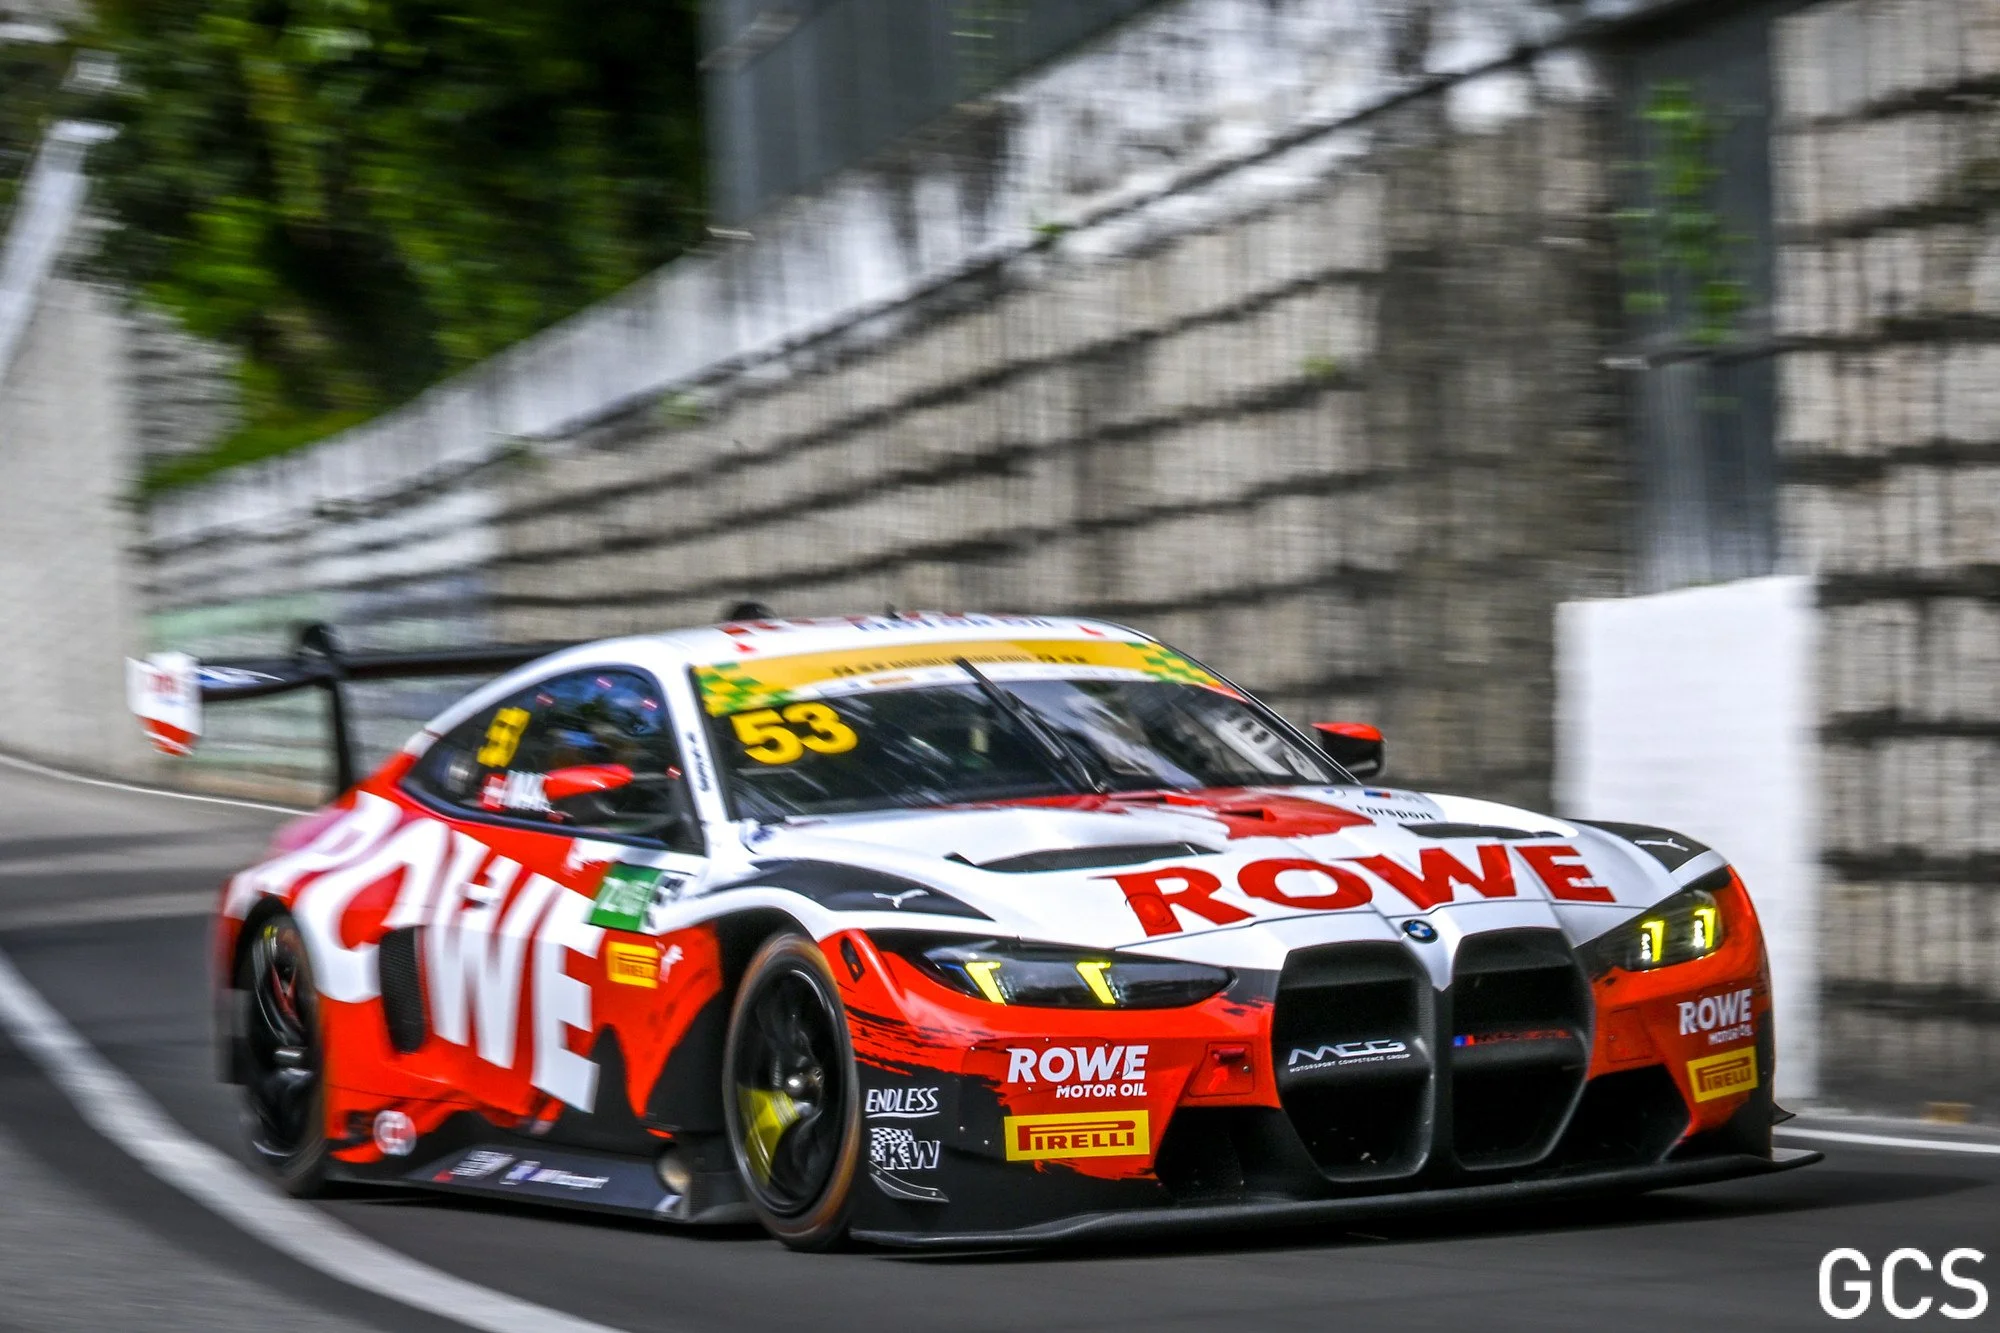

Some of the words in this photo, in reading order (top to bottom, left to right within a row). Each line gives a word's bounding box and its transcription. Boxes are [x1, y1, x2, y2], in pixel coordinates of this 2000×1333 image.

[729, 701, 858, 765] 53
[1087, 843, 1617, 938] ROWE
[1676, 988, 1752, 1035] ROWE
[1006, 1044, 1149, 1083] ROWE
[1289, 1061, 1335, 1073] MOTORSPORT
[1338, 1056, 1385, 1066] COMPETENCE
[1696, 1056, 1752, 1093] PIRELLI
[865, 1087, 939, 1113] ENDLESS
[1055, 1084, 1116, 1098] MOTOR
[1120, 1083, 1147, 1097] OIL
[1017, 1120, 1136, 1151] PIRELLI
[882, 1140, 941, 1170] KW
